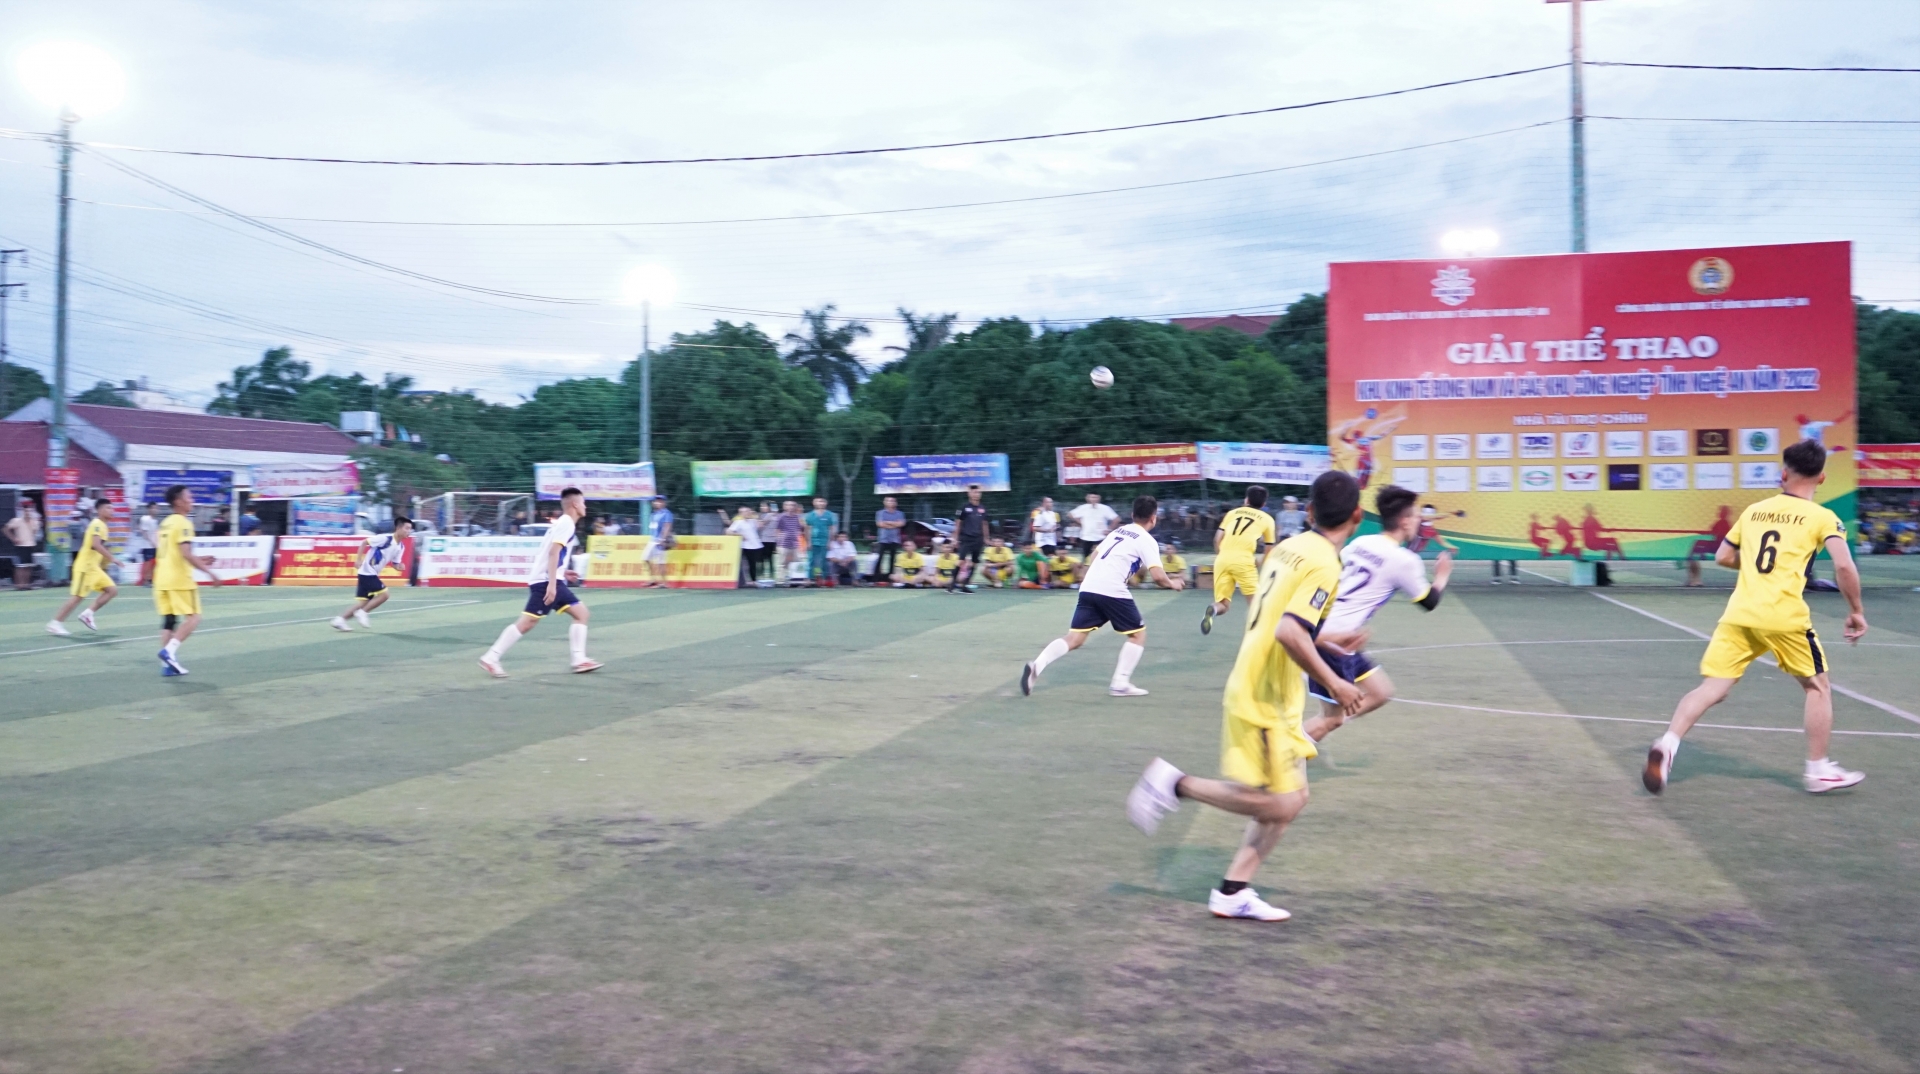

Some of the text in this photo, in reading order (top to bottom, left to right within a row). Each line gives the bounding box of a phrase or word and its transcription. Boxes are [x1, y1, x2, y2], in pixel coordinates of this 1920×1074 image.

[1447, 326, 1719, 364] GIẢI THỂ THAO
[1232, 516, 1255, 536] 17
[1750, 511, 1807, 526] BIOMASS FC
[1101, 536, 1125, 560] 7
[1755, 530, 1781, 574] 6
